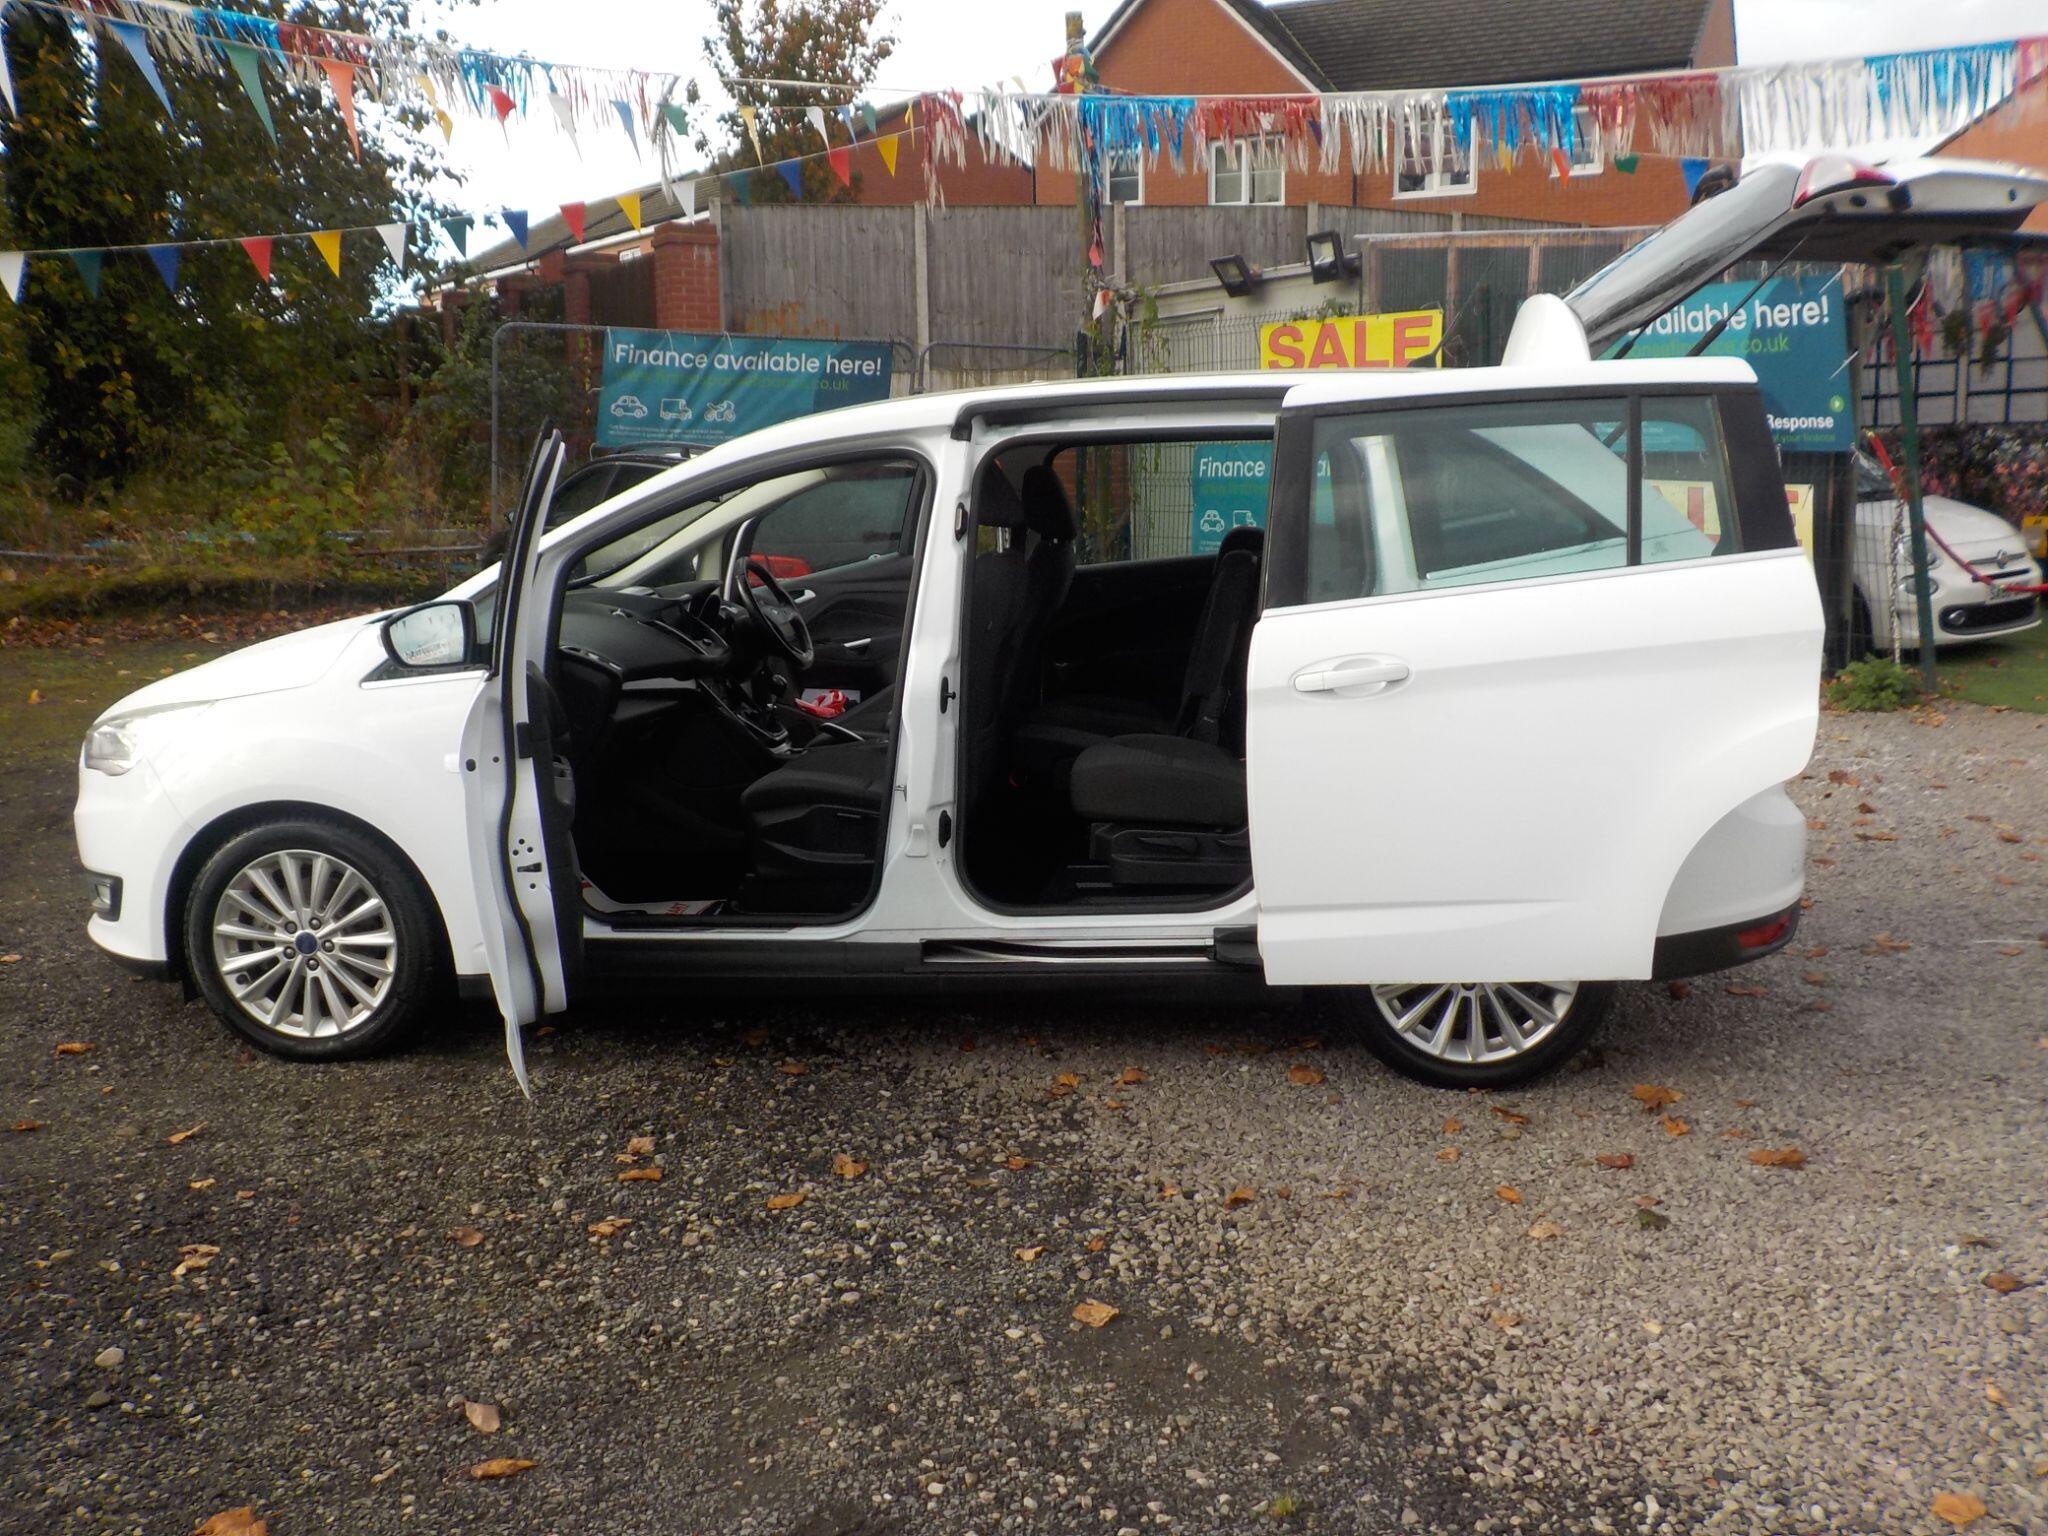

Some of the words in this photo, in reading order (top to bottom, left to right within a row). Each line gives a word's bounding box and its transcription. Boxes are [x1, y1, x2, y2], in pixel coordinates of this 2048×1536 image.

[1754, 295, 1830, 329] here!
[1268, 316, 1433, 368] SALE
[615, 343, 708, 368] Finance
[713, 351, 820, 374] available
[826, 354, 881, 376] here!
[1766, 413, 1834, 432] Response
[1199, 456, 1266, 478] Finance
